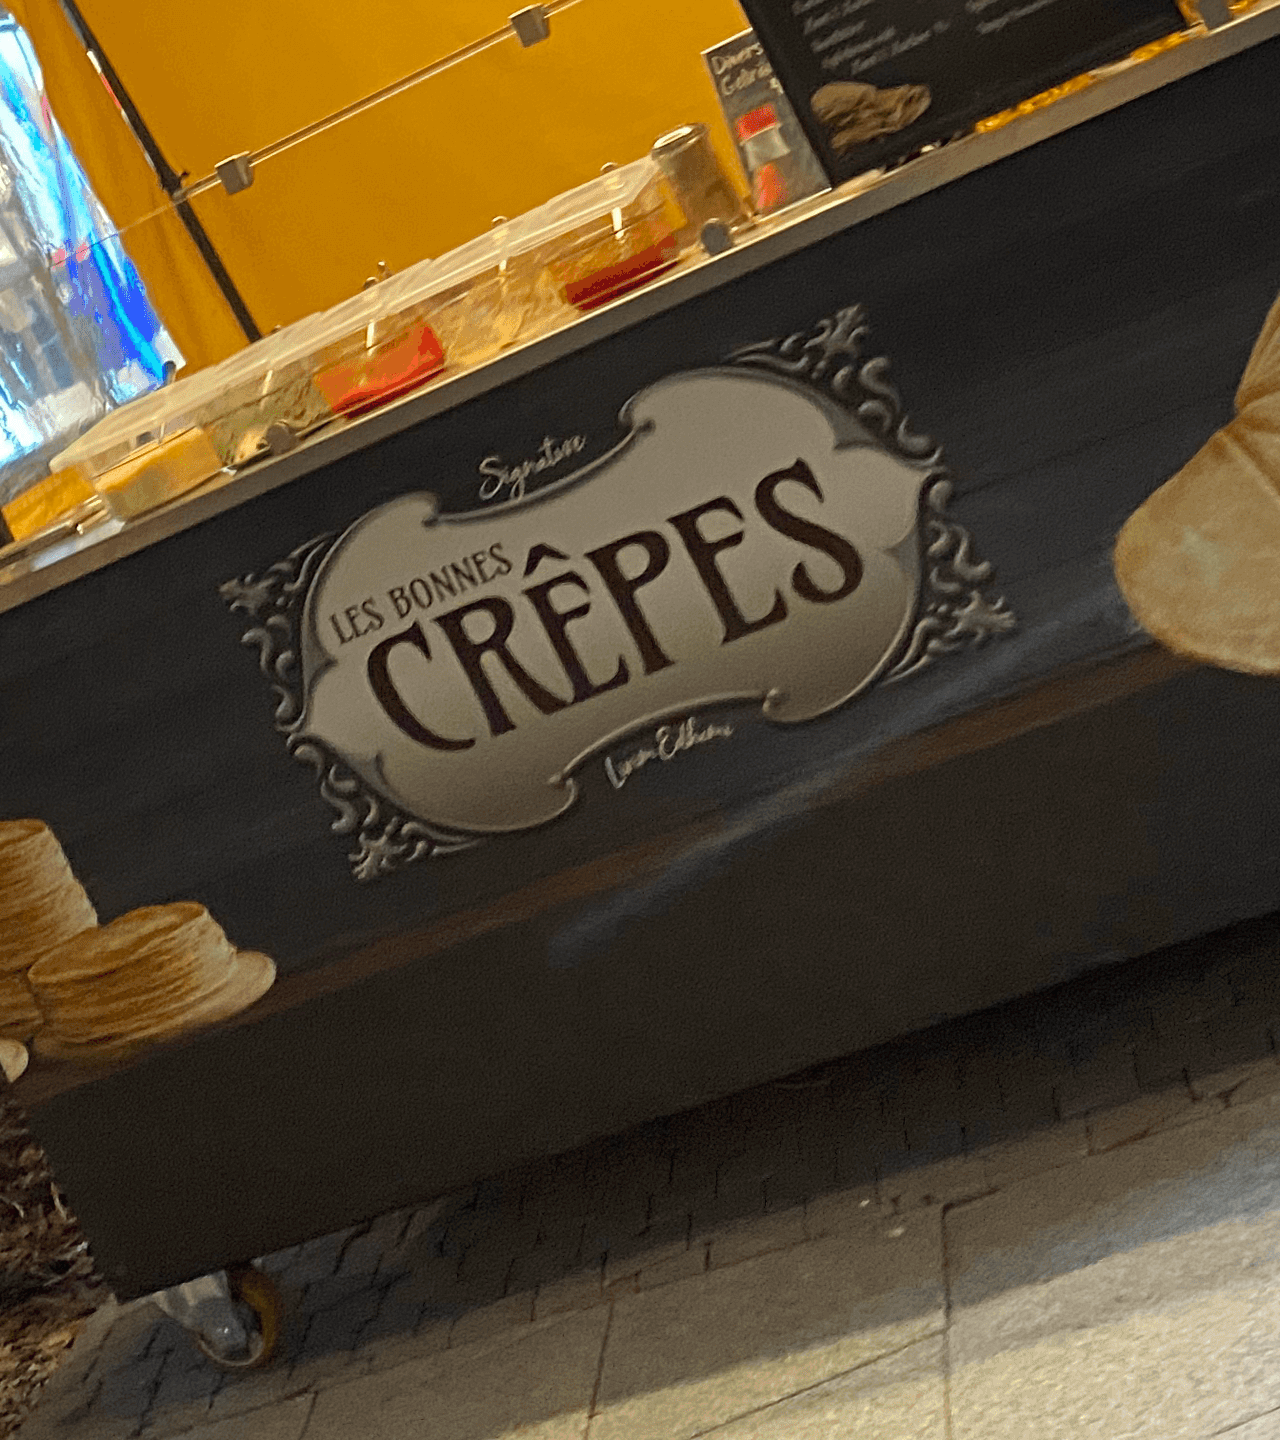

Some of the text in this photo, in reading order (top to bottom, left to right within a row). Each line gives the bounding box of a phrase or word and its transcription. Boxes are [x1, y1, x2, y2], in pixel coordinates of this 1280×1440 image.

[328, 542, 515, 646] LES BONNES
[367, 457, 864, 752] CRÊPES
